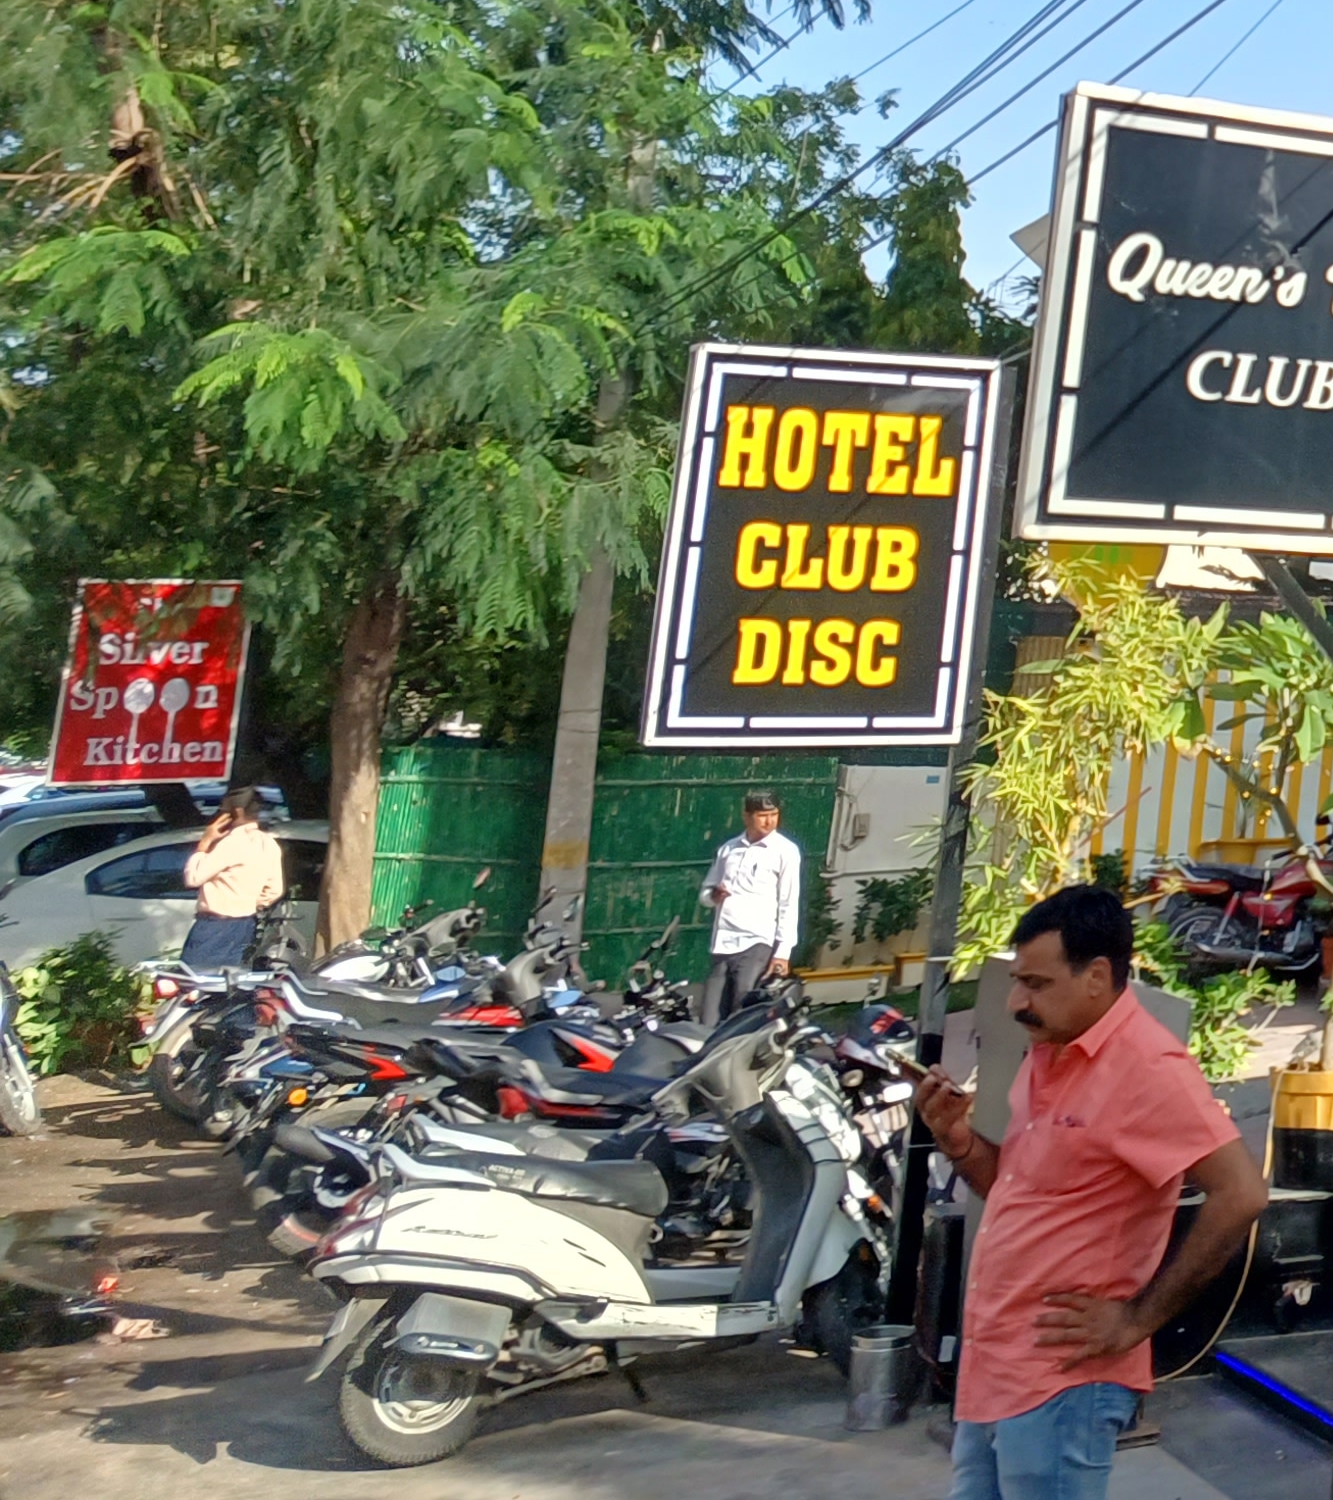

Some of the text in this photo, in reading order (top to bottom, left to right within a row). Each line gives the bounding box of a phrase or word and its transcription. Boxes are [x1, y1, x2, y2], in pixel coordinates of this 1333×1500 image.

[1107, 231, 1308, 308] Queen's
[717, 405, 956, 497] HOTEL
[735, 521, 920, 592] CLUB
[732, 617, 900, 688] DISC
[83, 735, 223, 767] Kitchen
